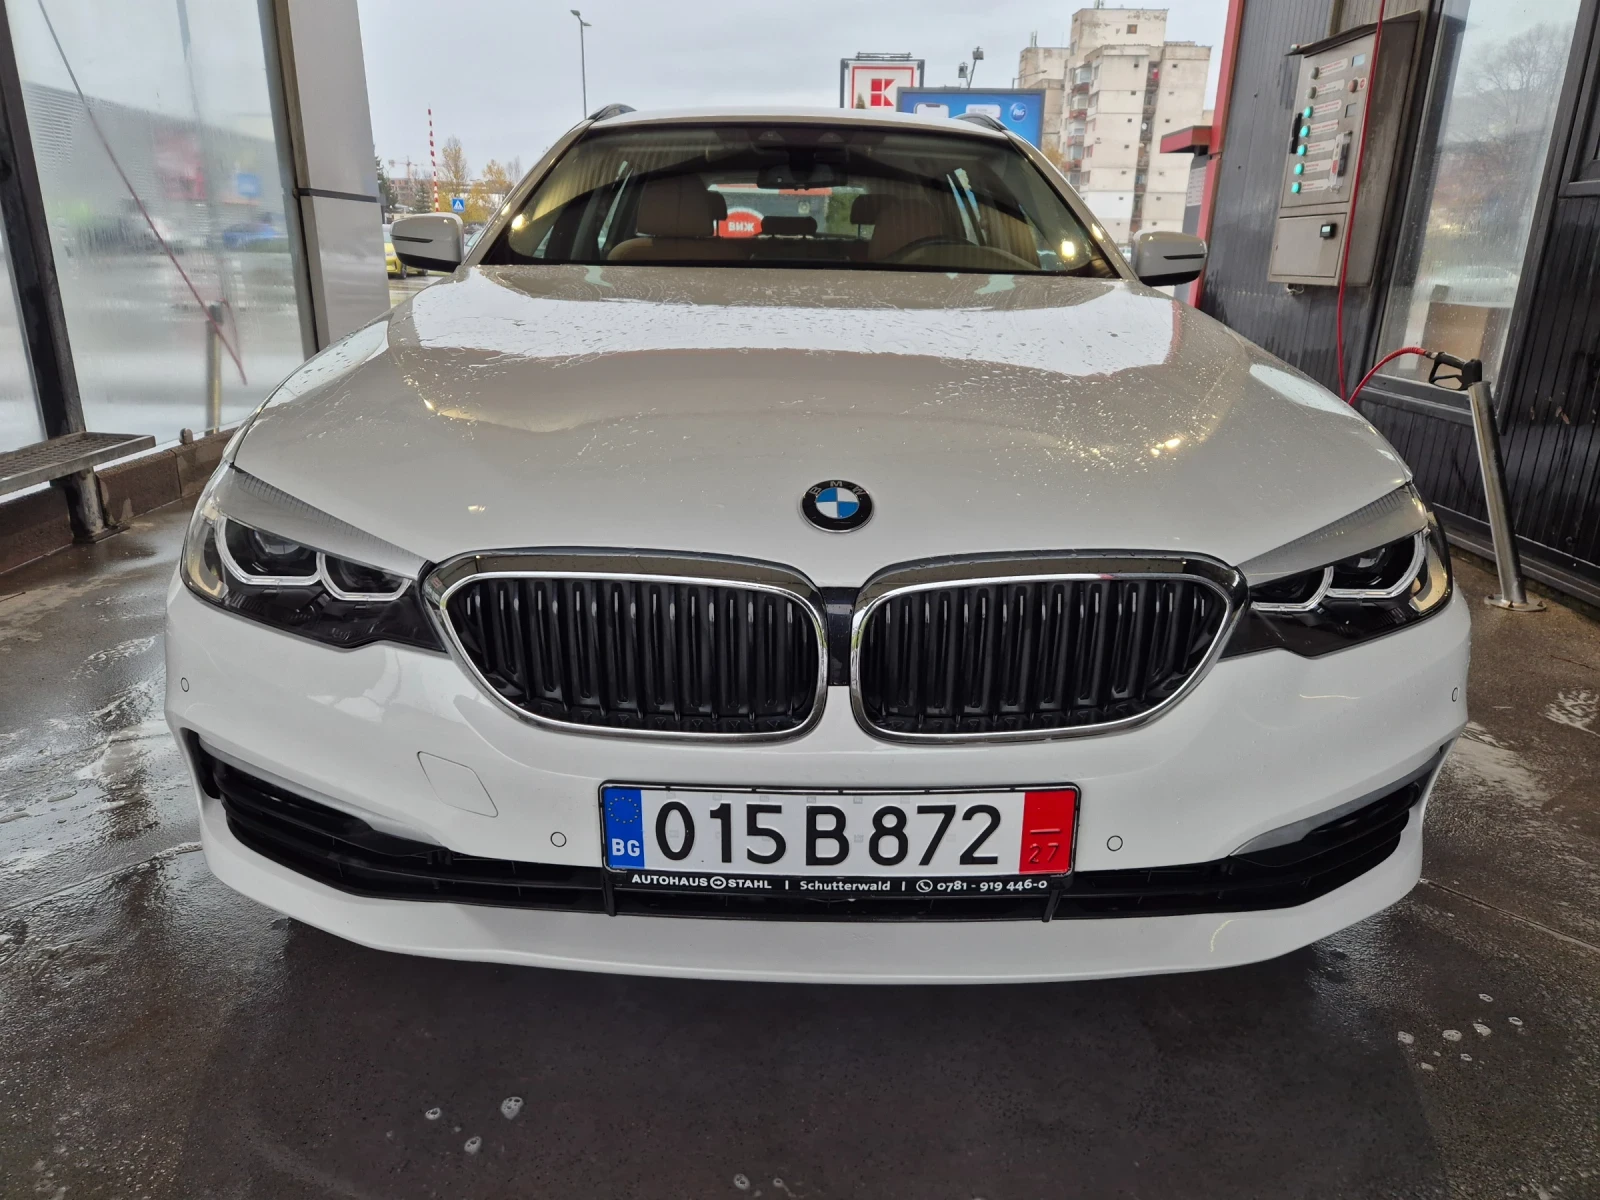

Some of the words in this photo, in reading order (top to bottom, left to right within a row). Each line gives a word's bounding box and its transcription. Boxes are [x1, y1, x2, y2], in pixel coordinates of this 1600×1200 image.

[728, 221, 755, 232] ВИЖ
[808, 480, 867, 496] BMW
[611, 838, 641, 857] BG
[1028, 842, 1060, 864] 27
[631, 874, 708, 887] AUTOHAUS
[728, 878, 772, 890] STAHL
[800, 880, 891, 891] Schutterwald
[937, 881, 967, 893] 0781
[979, 881, 1003, 892] 919
[1006, 879, 1048, 892] 446-0
